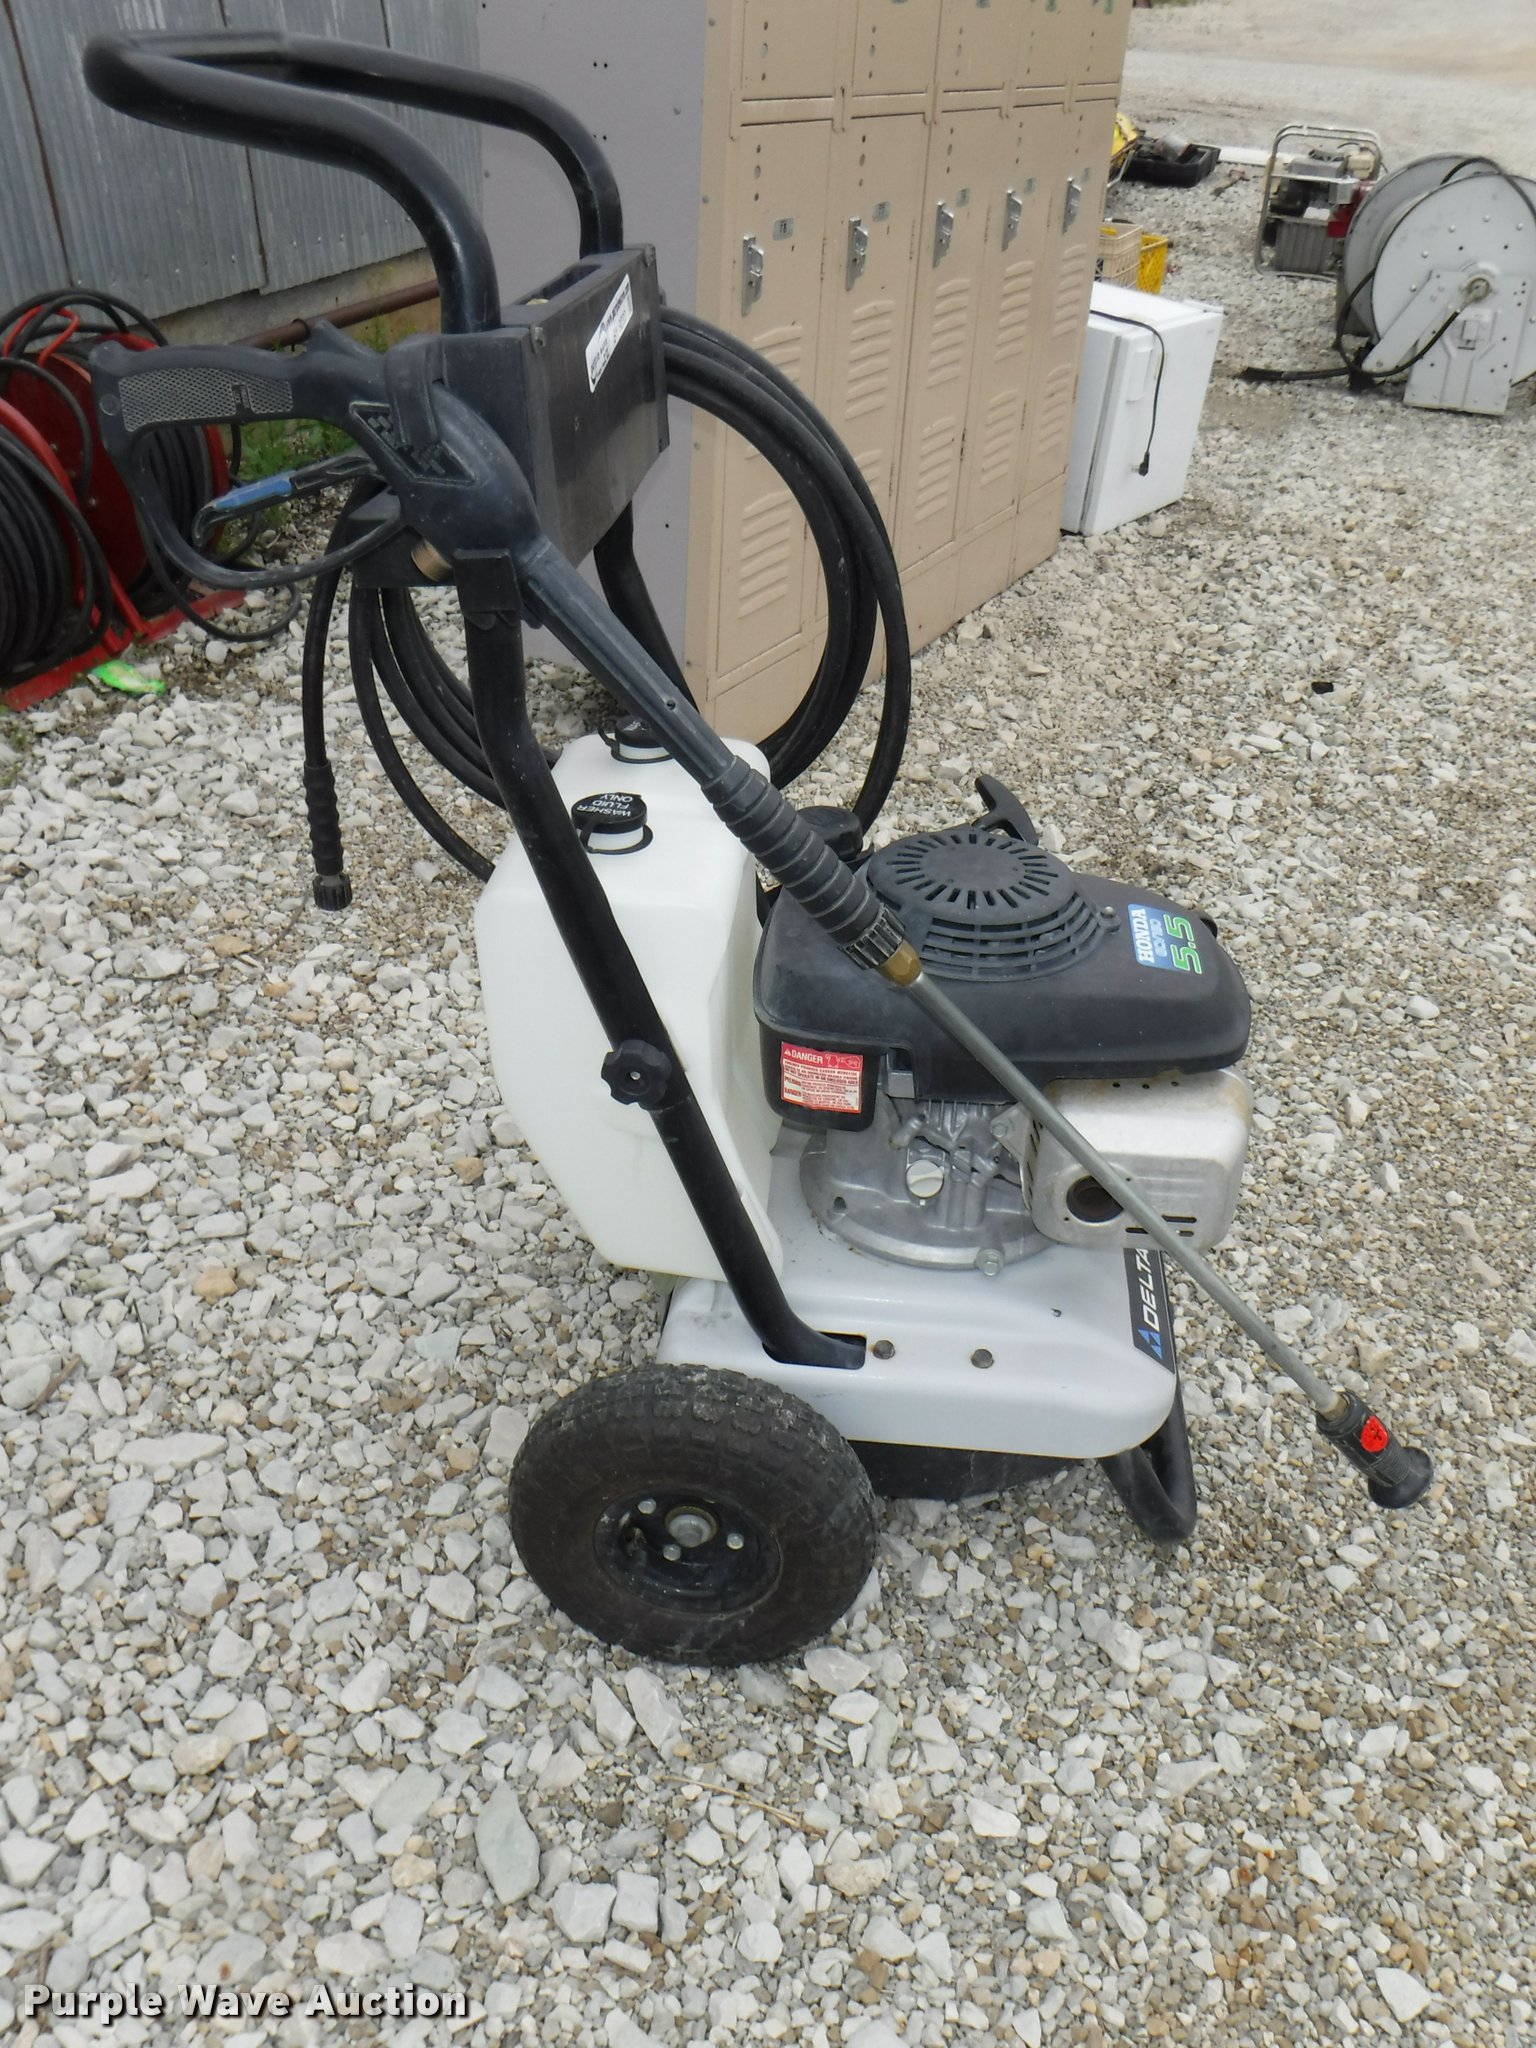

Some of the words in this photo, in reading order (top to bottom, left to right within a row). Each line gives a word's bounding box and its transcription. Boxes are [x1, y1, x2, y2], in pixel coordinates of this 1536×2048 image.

[592, 799, 630, 810] FLUID
[600, 794, 633, 803] ONLY
[576, 804, 631, 817] WASHER
[1131, 908, 1155, 963] HONDA
[1163, 913, 1202, 975] 5.5
[791, 1049, 823, 1064] DANGER
[1135, 1248, 1160, 1332] DELTA
